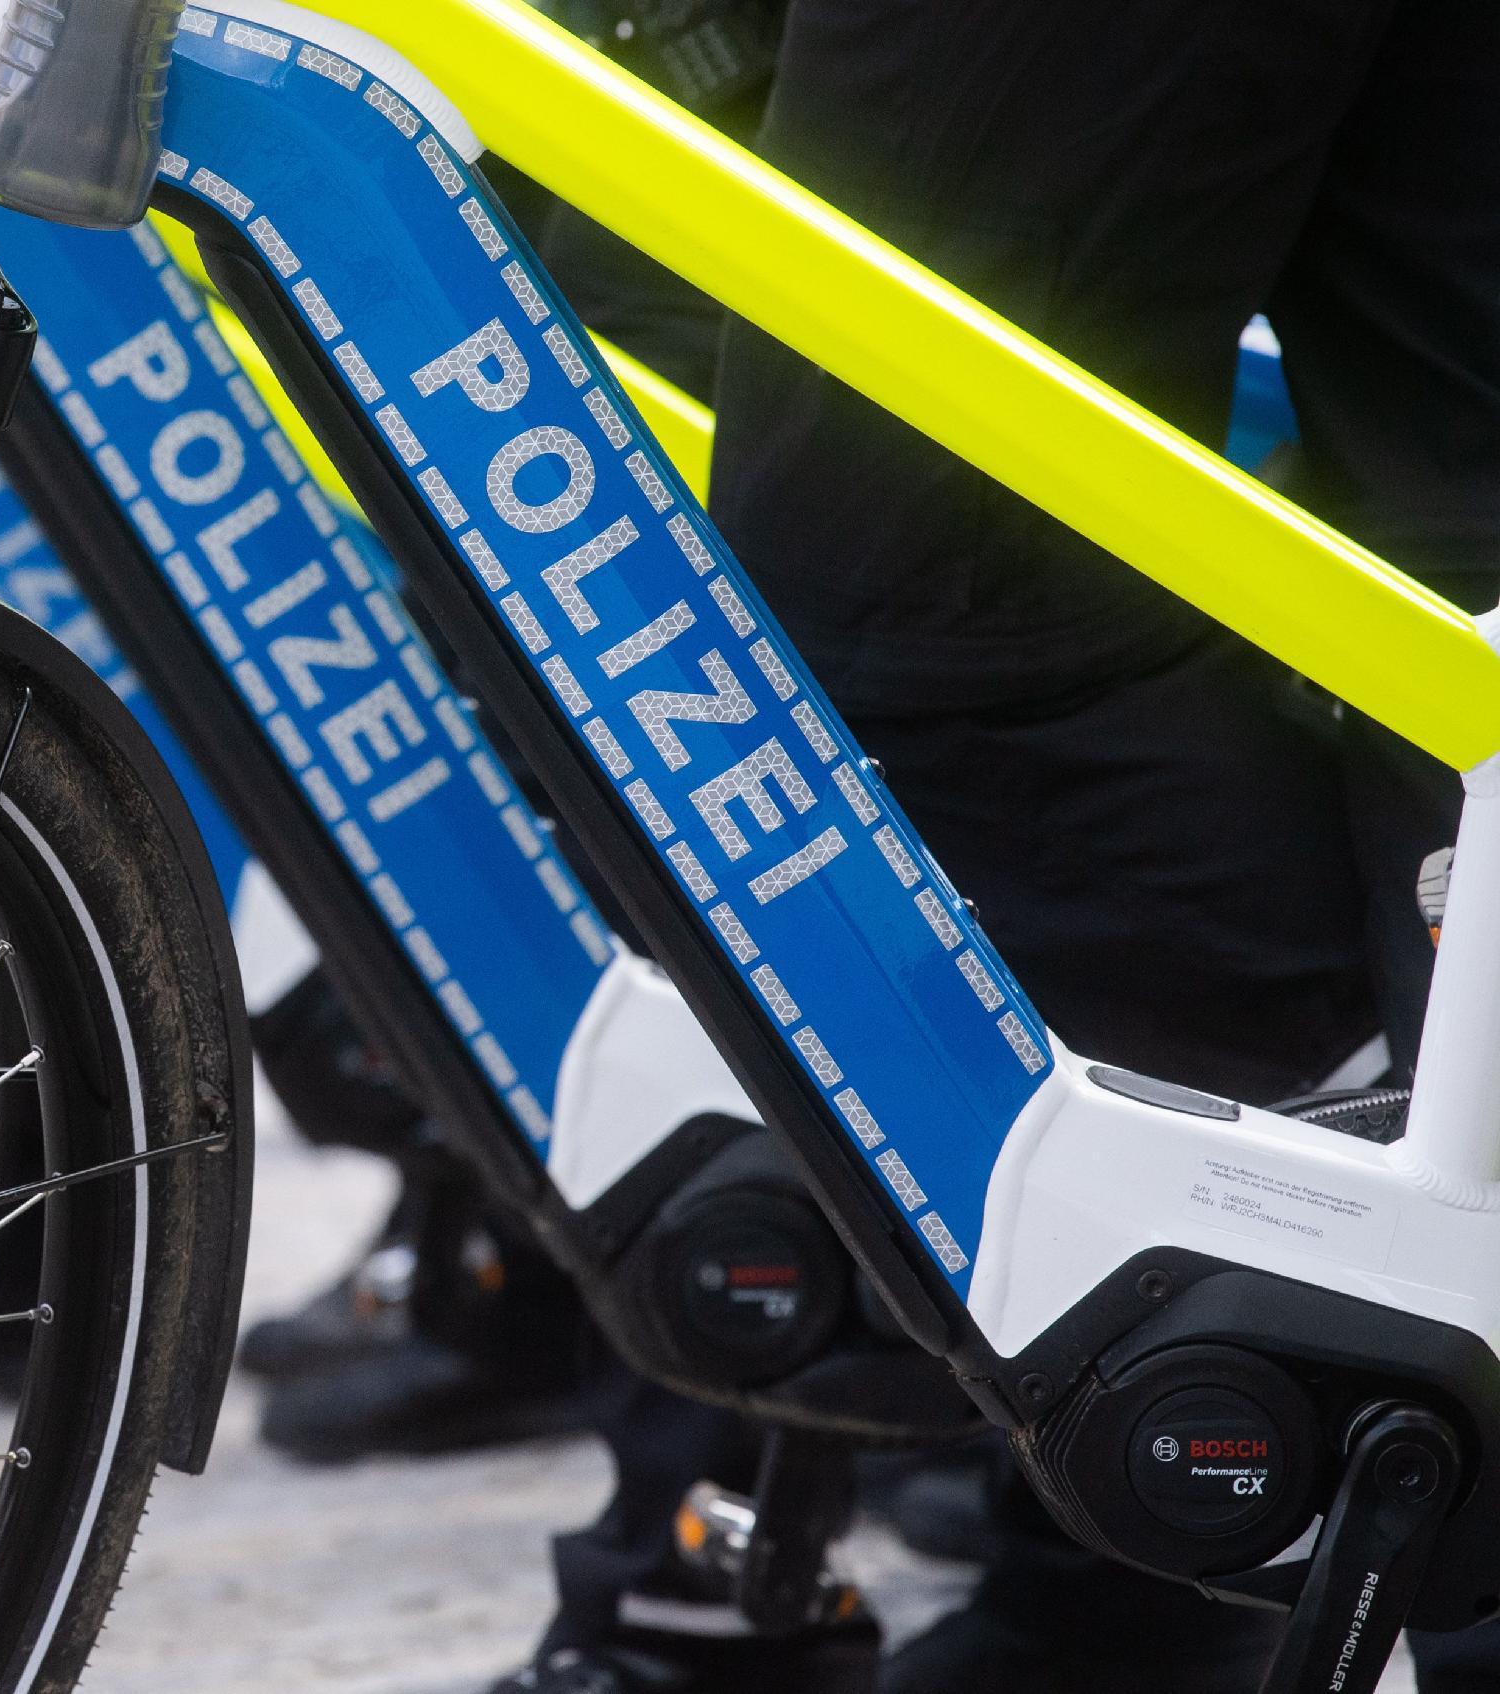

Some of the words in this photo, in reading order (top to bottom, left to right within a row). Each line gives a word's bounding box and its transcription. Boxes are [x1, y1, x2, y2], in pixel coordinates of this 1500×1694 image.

[88, 320, 451, 823] POLIZEI
[410, 316, 848, 905] POLIZEI
[1190, 1440, 1267, 1457] BOSCH
[1233, 1477, 1266, 1495] CX
[1354, 1572, 1379, 1621] RIESE
